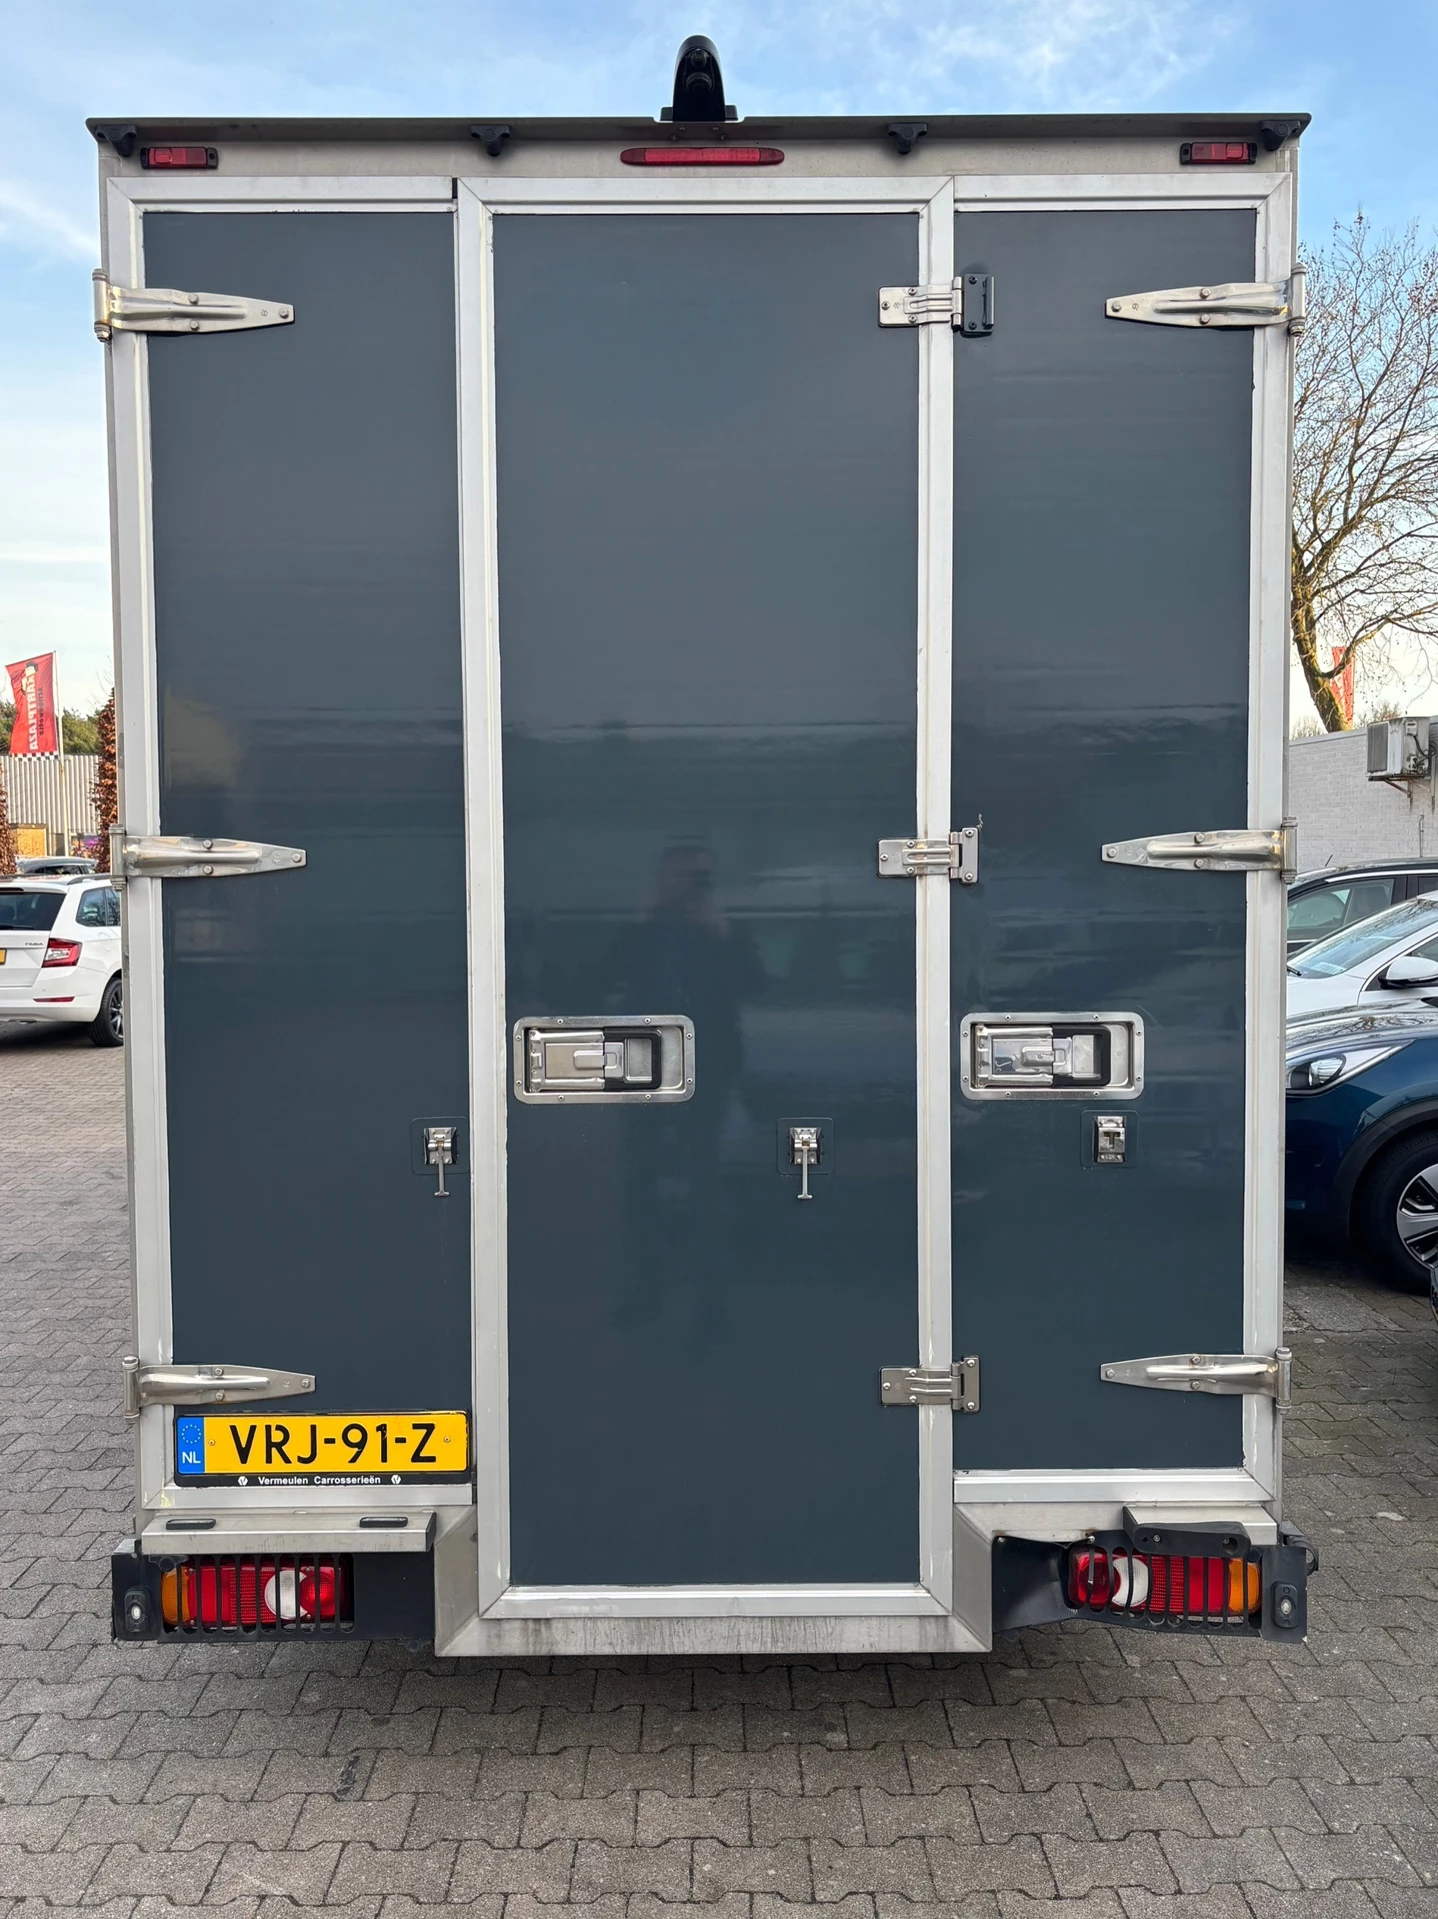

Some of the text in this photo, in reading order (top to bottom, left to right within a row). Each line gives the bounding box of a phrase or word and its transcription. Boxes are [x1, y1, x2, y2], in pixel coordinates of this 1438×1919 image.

[229, 1423, 437, 1464] VRJ-91-Z
[182, 1452, 201, 1464] NL
[258, 1475, 381, 1486] Vermeulen Carrosserieën
